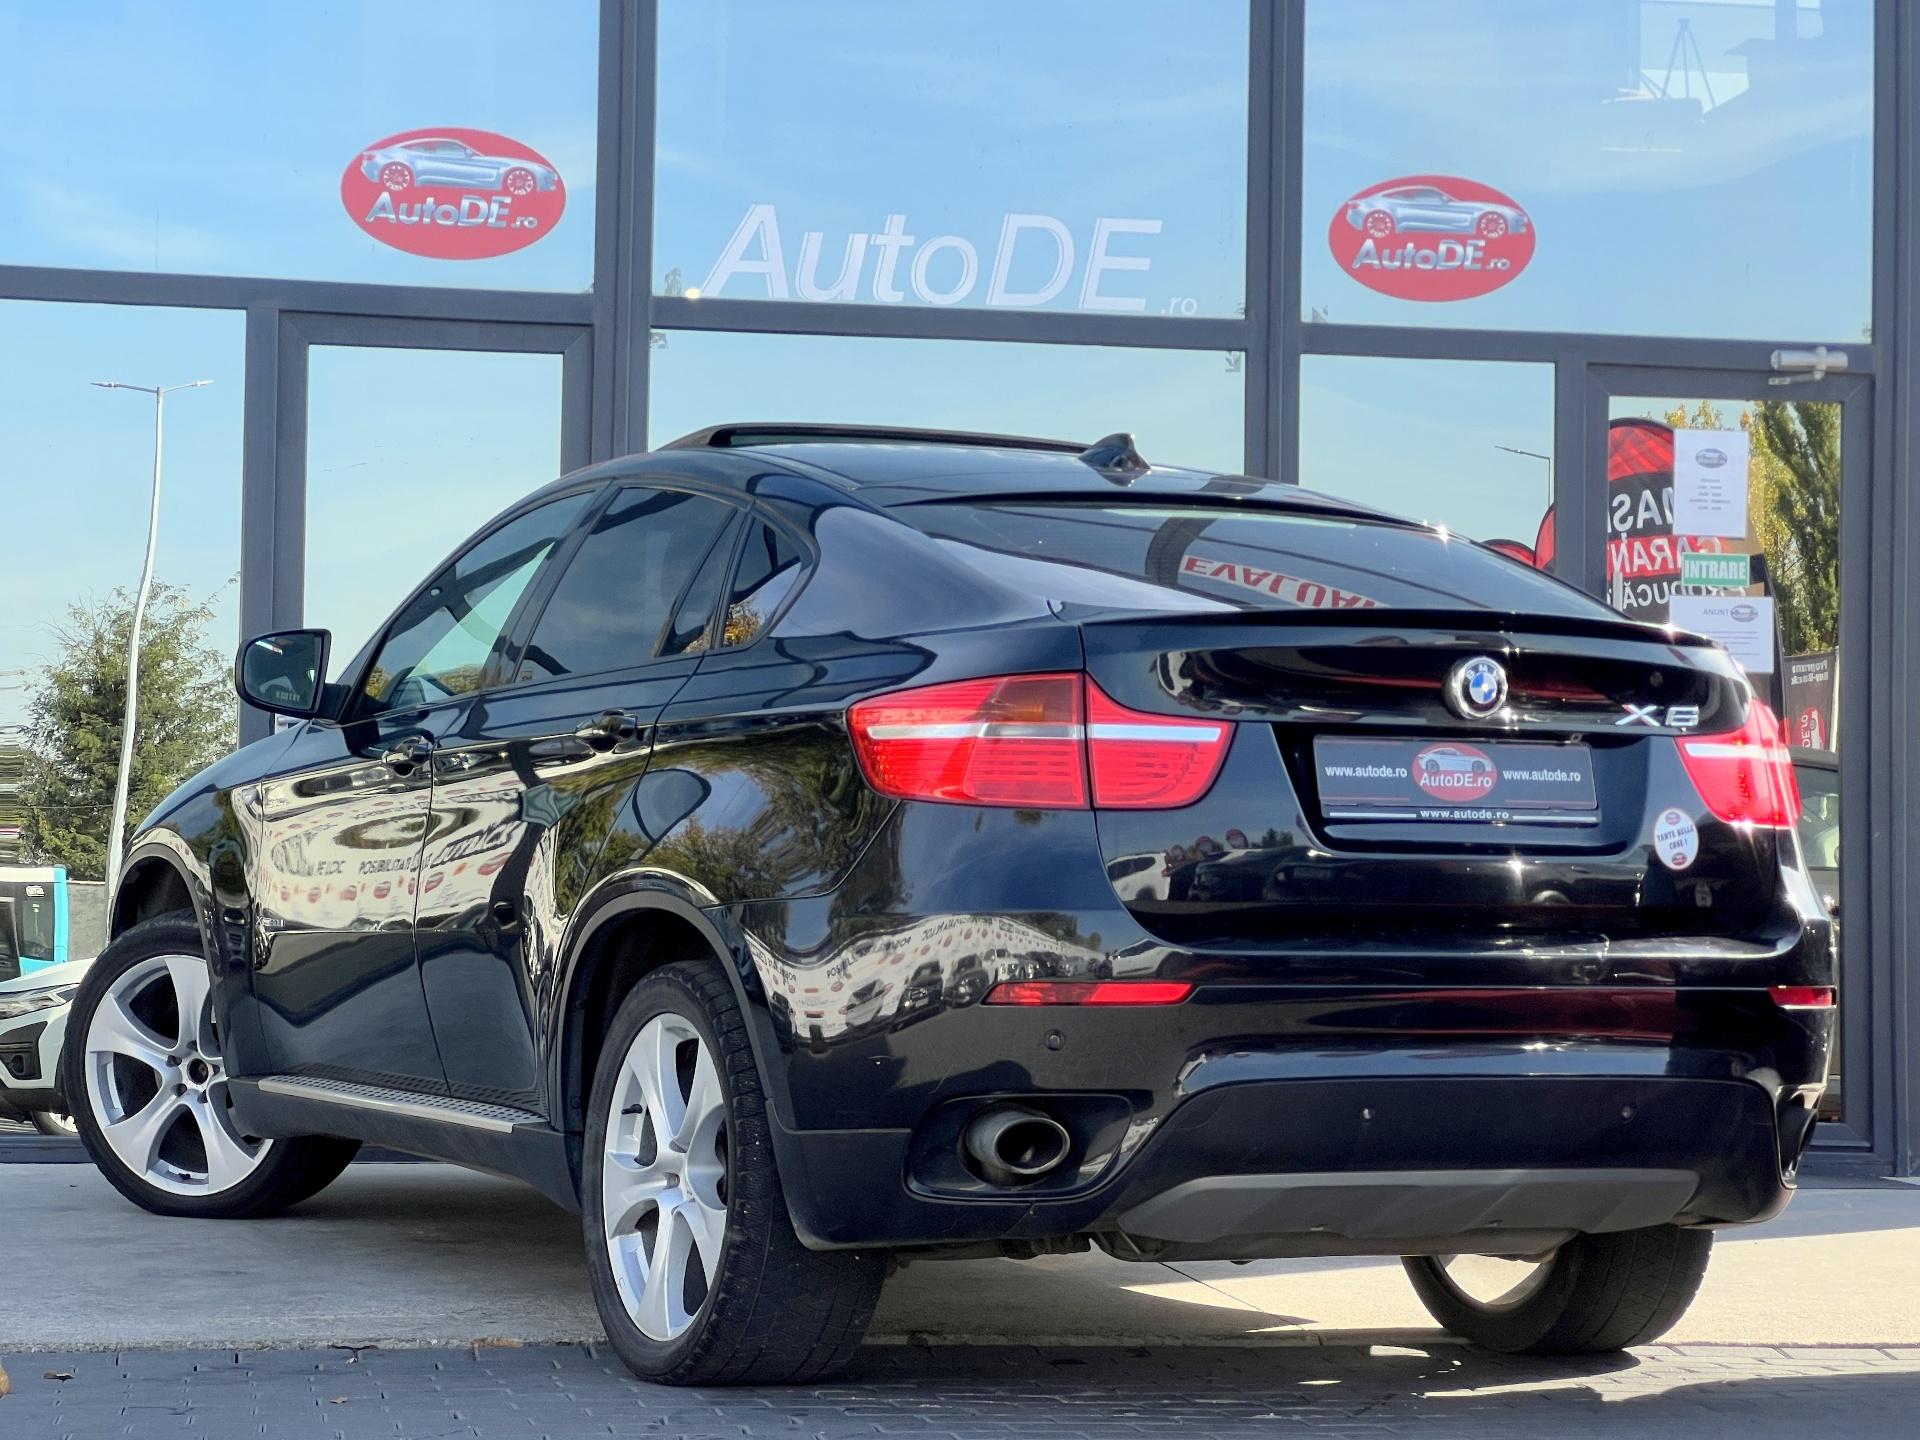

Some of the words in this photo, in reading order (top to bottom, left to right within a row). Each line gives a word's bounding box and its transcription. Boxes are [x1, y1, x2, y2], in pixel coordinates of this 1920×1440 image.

[1684, 561, 1746, 579] INTRARE
[1615, 703, 1700, 727] X6
[1325, 765, 1408, 778] www.autode.ro
[1419, 772, 1492, 788] AutoDE.ro
[1502, 768, 1581, 782] www.autode.ro
[1420, 809, 1509, 820] www.autode.ro
